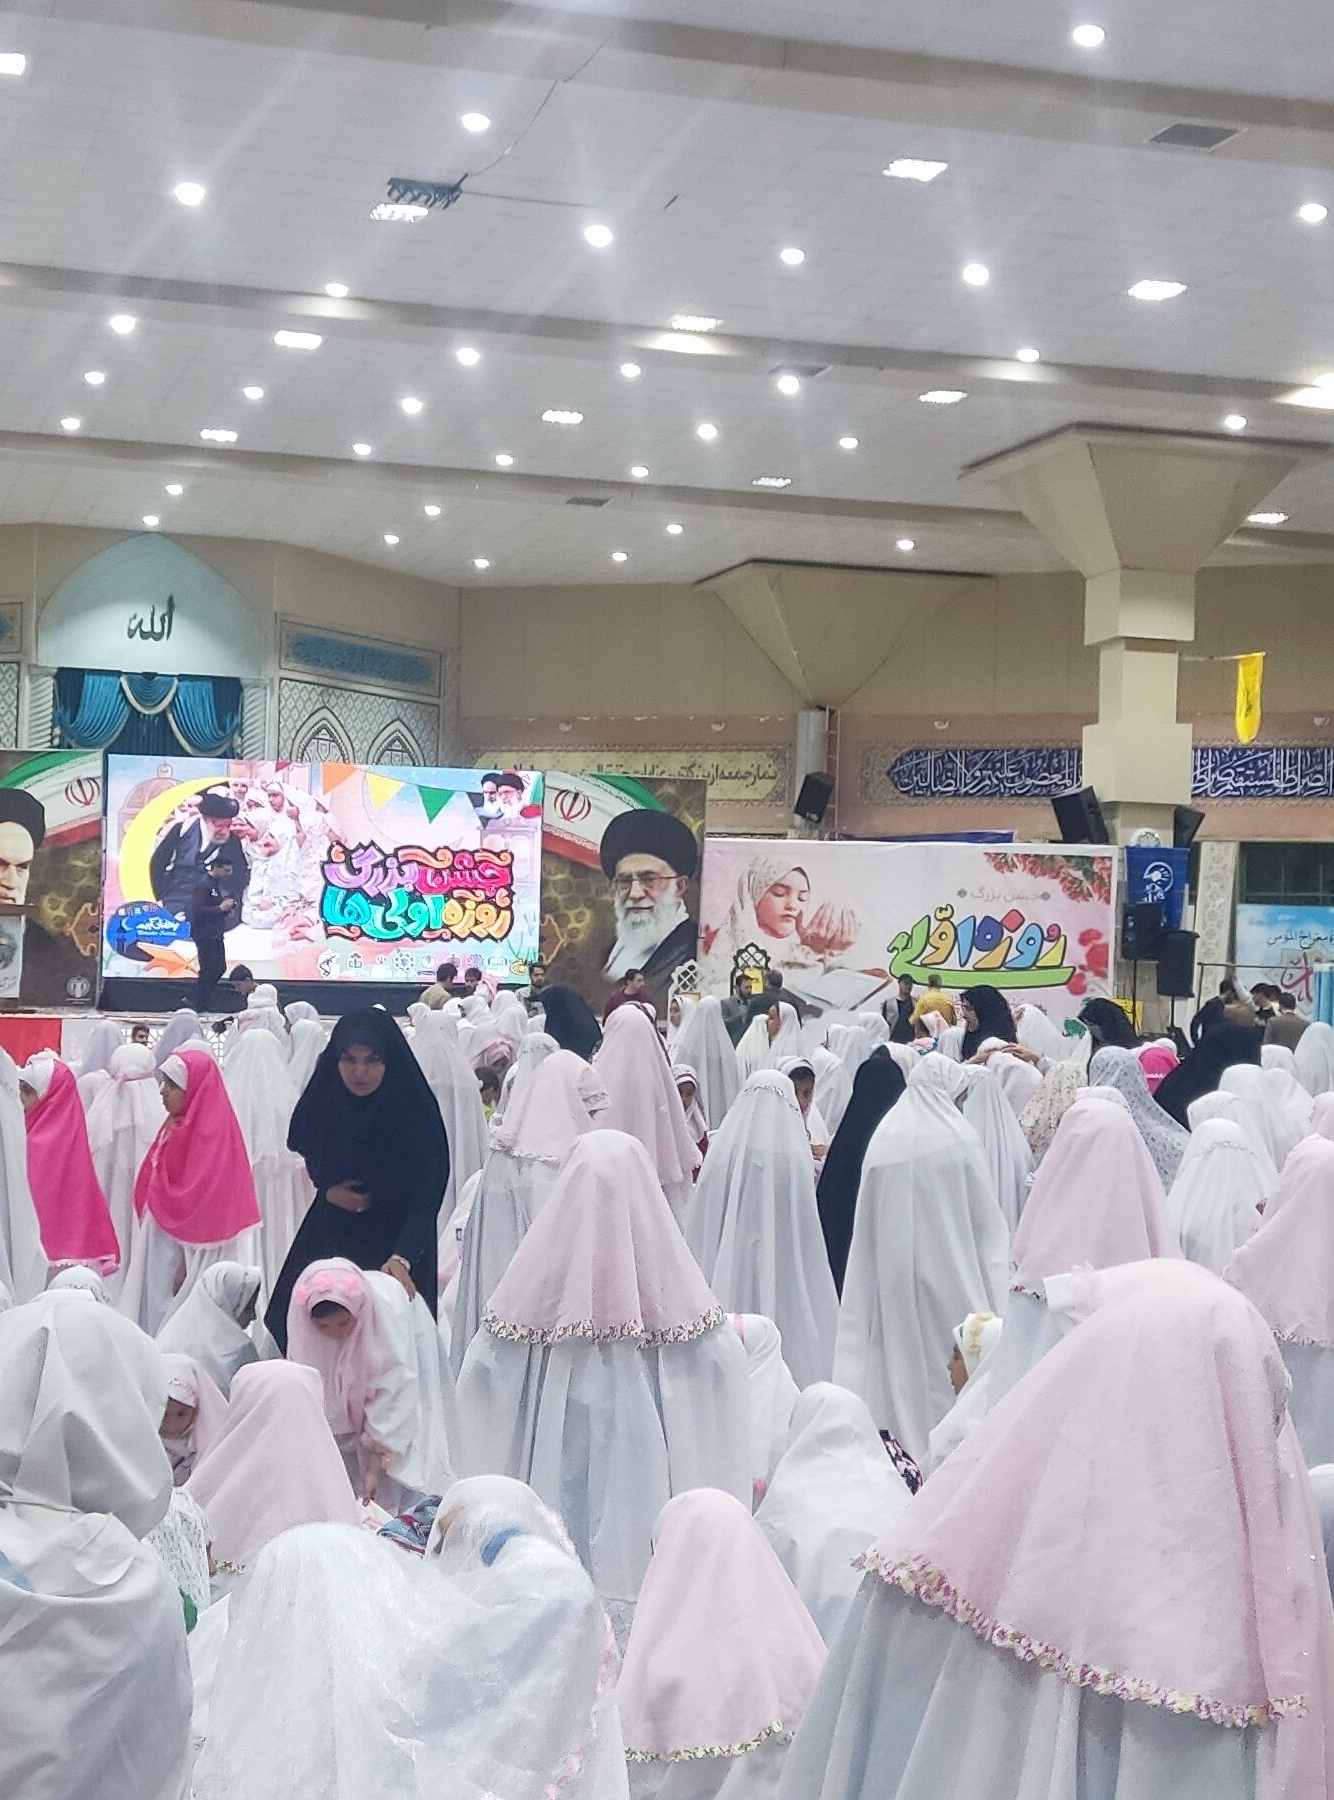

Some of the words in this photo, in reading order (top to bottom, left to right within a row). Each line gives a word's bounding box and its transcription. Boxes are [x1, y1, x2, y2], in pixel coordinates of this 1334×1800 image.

[127, 594, 175, 641] الله
[323, 845, 418, 898] بزرگ
[416, 850, 512, 897] جشن
[441, 898, 511, 939] روزه
[972, 908, 1068, 970] روزه
